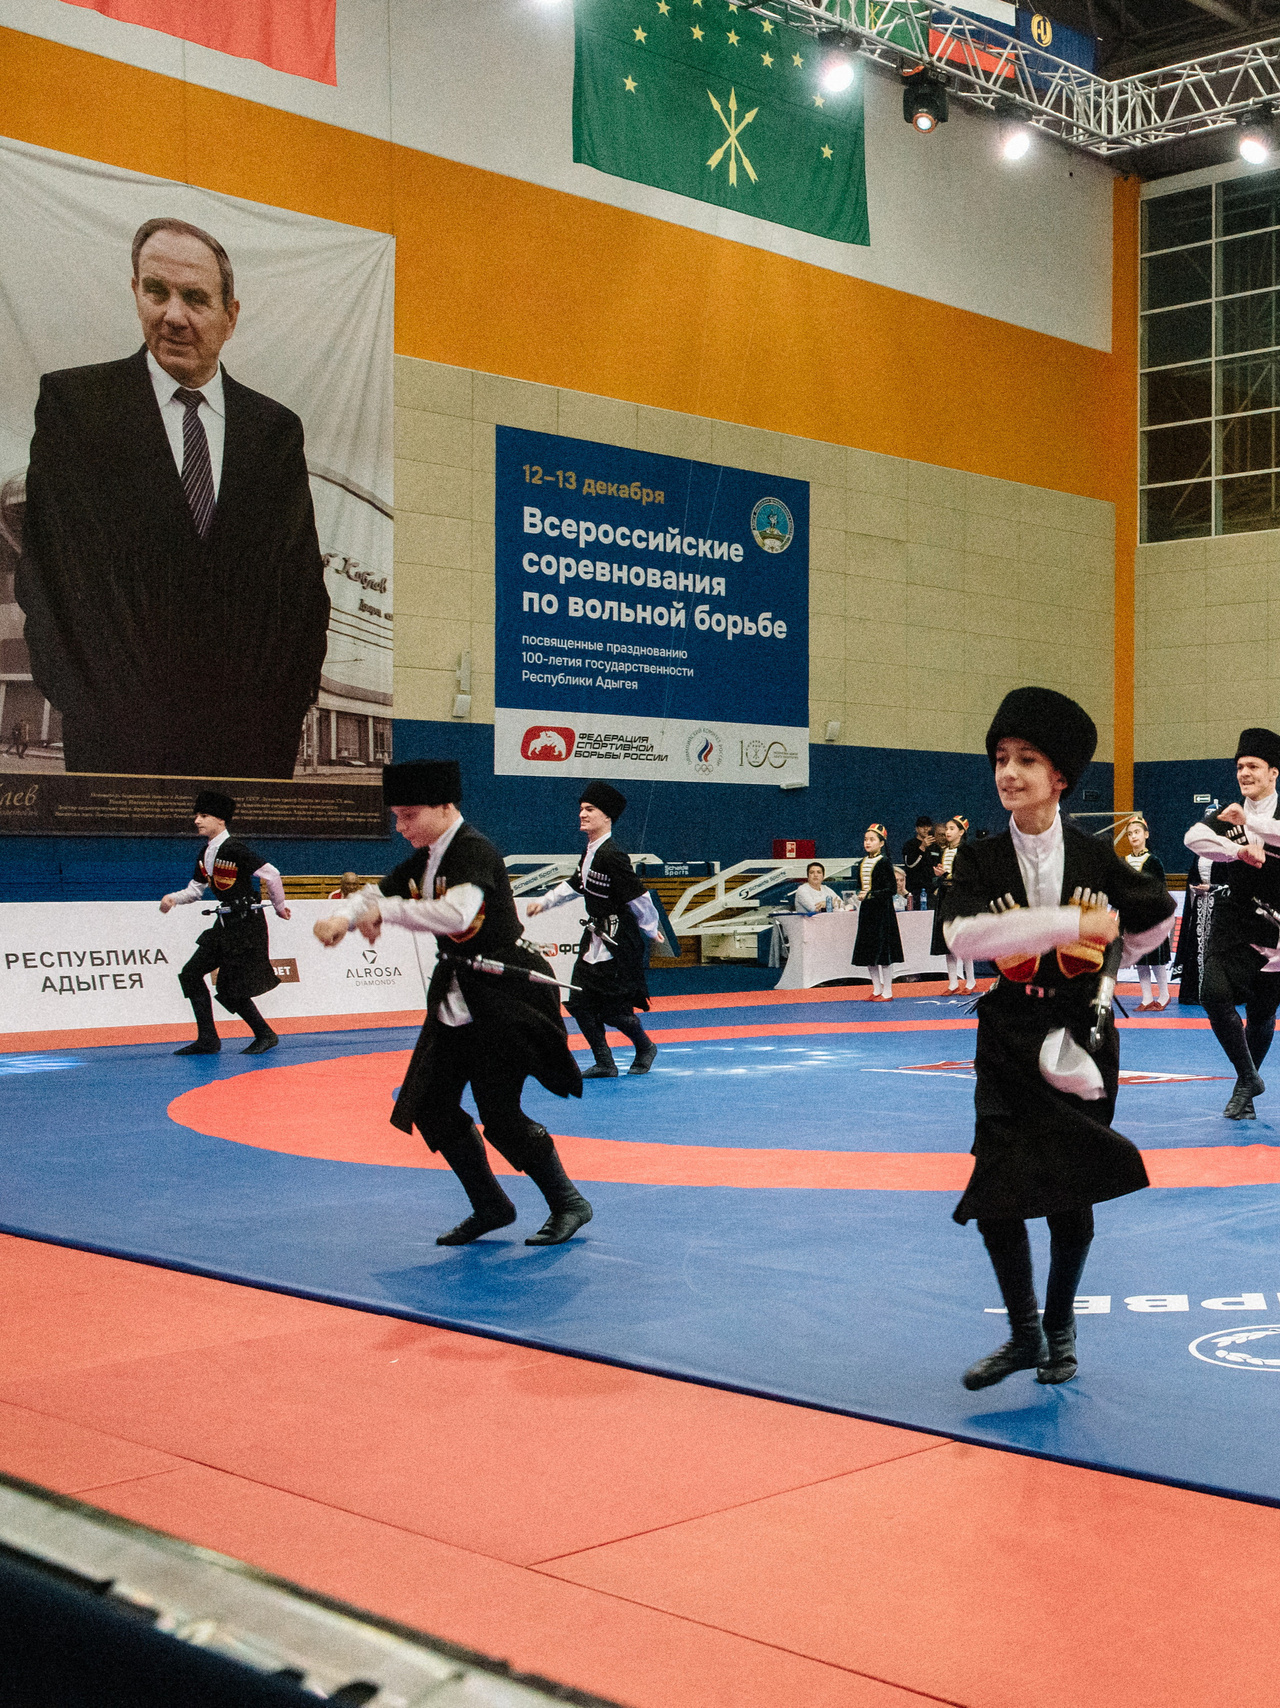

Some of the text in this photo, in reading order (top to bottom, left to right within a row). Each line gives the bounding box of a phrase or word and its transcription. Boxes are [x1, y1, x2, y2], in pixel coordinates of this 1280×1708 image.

[583, 476, 665, 505] декабря
[523, 505, 744, 563] Всероссийские
[522, 551, 726, 597] соревнования
[523, 590, 787, 640] по вольной борьбе
[522, 634, 688, 660] посвященные празднованию
[522, 651, 694, 677] 100-летия государственности
[522, 669, 638, 690] Республики Адыгея
[576, 741, 654, 752] СПОРТИВНОЙ
[578, 732, 649, 744] ФЕДЕРАЦИЯ
[574, 750, 669, 762] БОРЬБЫ РОССИИ
[4, 948, 169, 971] РЕСПУБЛИКА
[41, 972, 145, 995] АДЫГЕЯ
[346, 966, 402, 978] ALROSA
